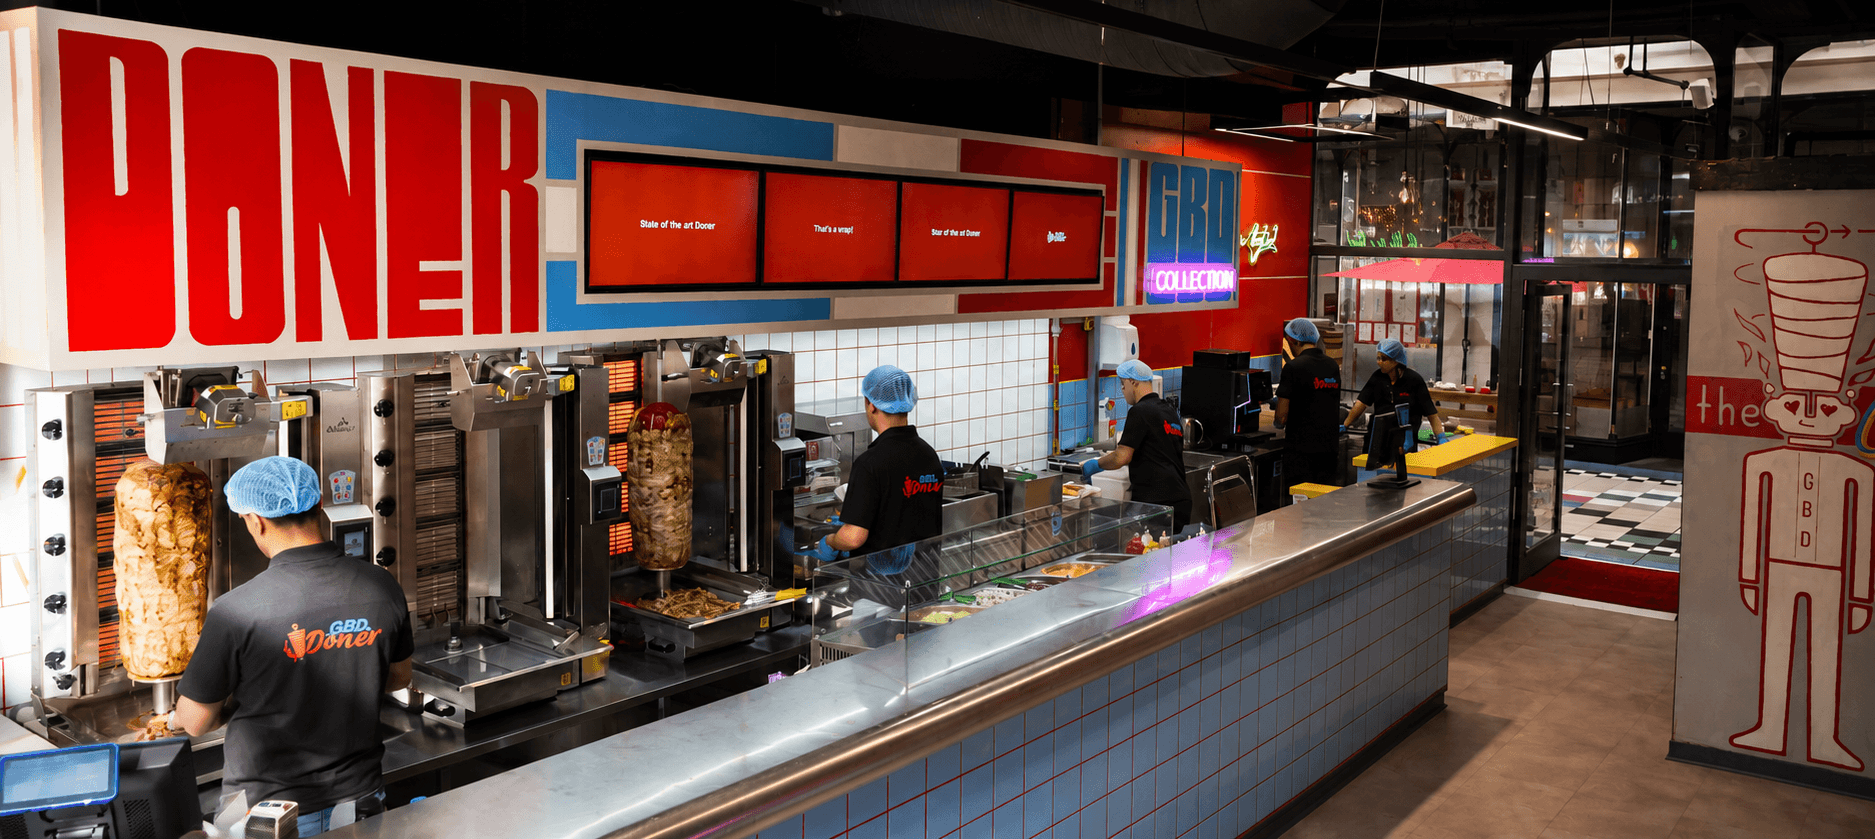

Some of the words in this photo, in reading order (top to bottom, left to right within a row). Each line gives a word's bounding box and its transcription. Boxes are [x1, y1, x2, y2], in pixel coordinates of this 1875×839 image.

[57, 28, 540, 352] DONER
[660, 219, 669, 229] of
[670, 220, 682, 229] the
[683, 221, 694, 230] art
[1146, 161, 1235, 305] GBD
[1155, 270, 1234, 292] COLLECTION
[1696, 384, 1761, 428] the
[305, 628, 383, 654] Doner
